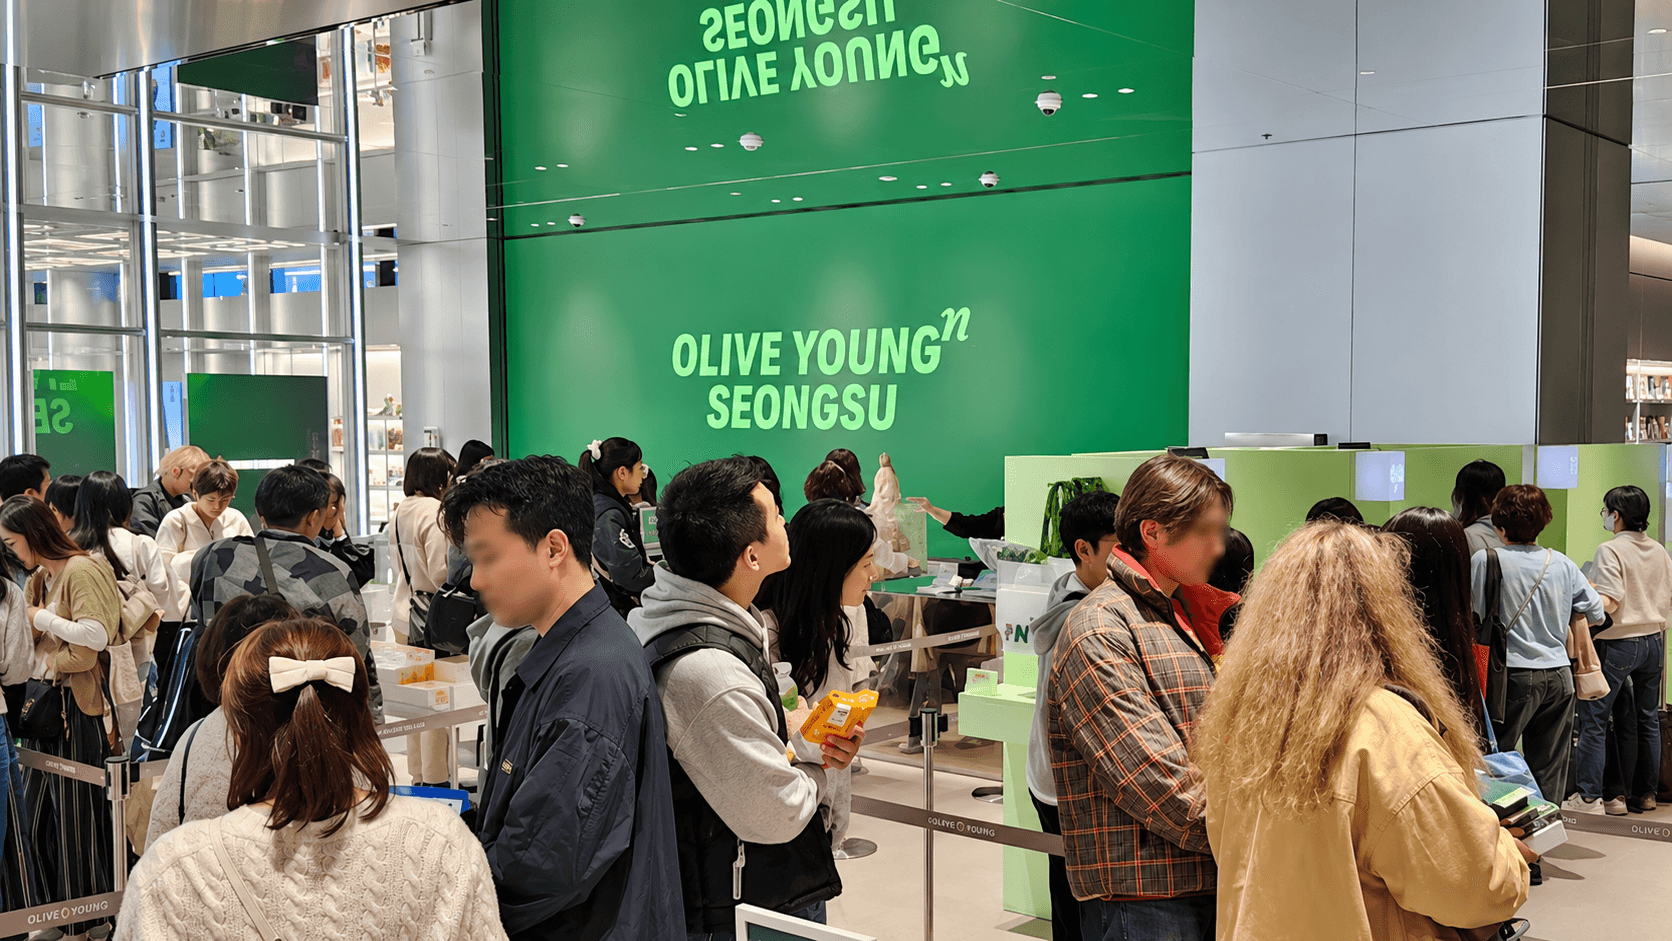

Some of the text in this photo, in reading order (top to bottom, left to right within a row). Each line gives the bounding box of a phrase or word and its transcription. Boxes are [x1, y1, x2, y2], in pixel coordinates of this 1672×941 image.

[672, 331, 783, 377] OLIVE
[706, 383, 898, 431] SEONGSU
[1631, 824, 1661, 836] OLIVE
[27, 900, 109, 925] OLIVE YOUNG
